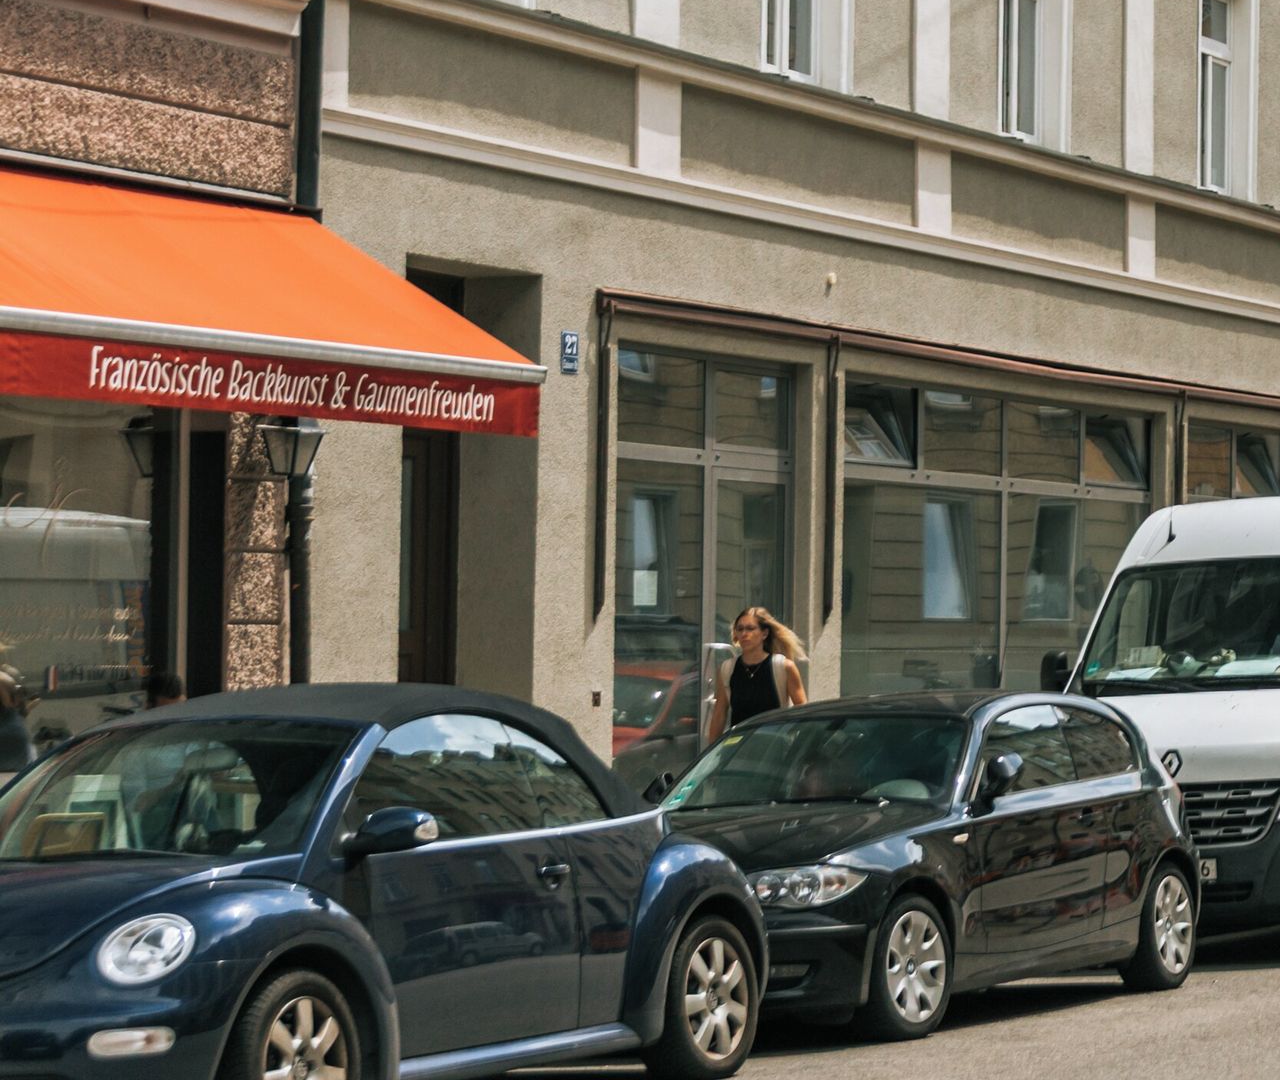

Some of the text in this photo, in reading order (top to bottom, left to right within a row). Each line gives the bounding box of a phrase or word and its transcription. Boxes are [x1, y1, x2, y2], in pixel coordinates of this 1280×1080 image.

[564, 334, 578, 355] 27
[89, 345, 496, 423] Französische Backkunst & Gaumenfreuden
